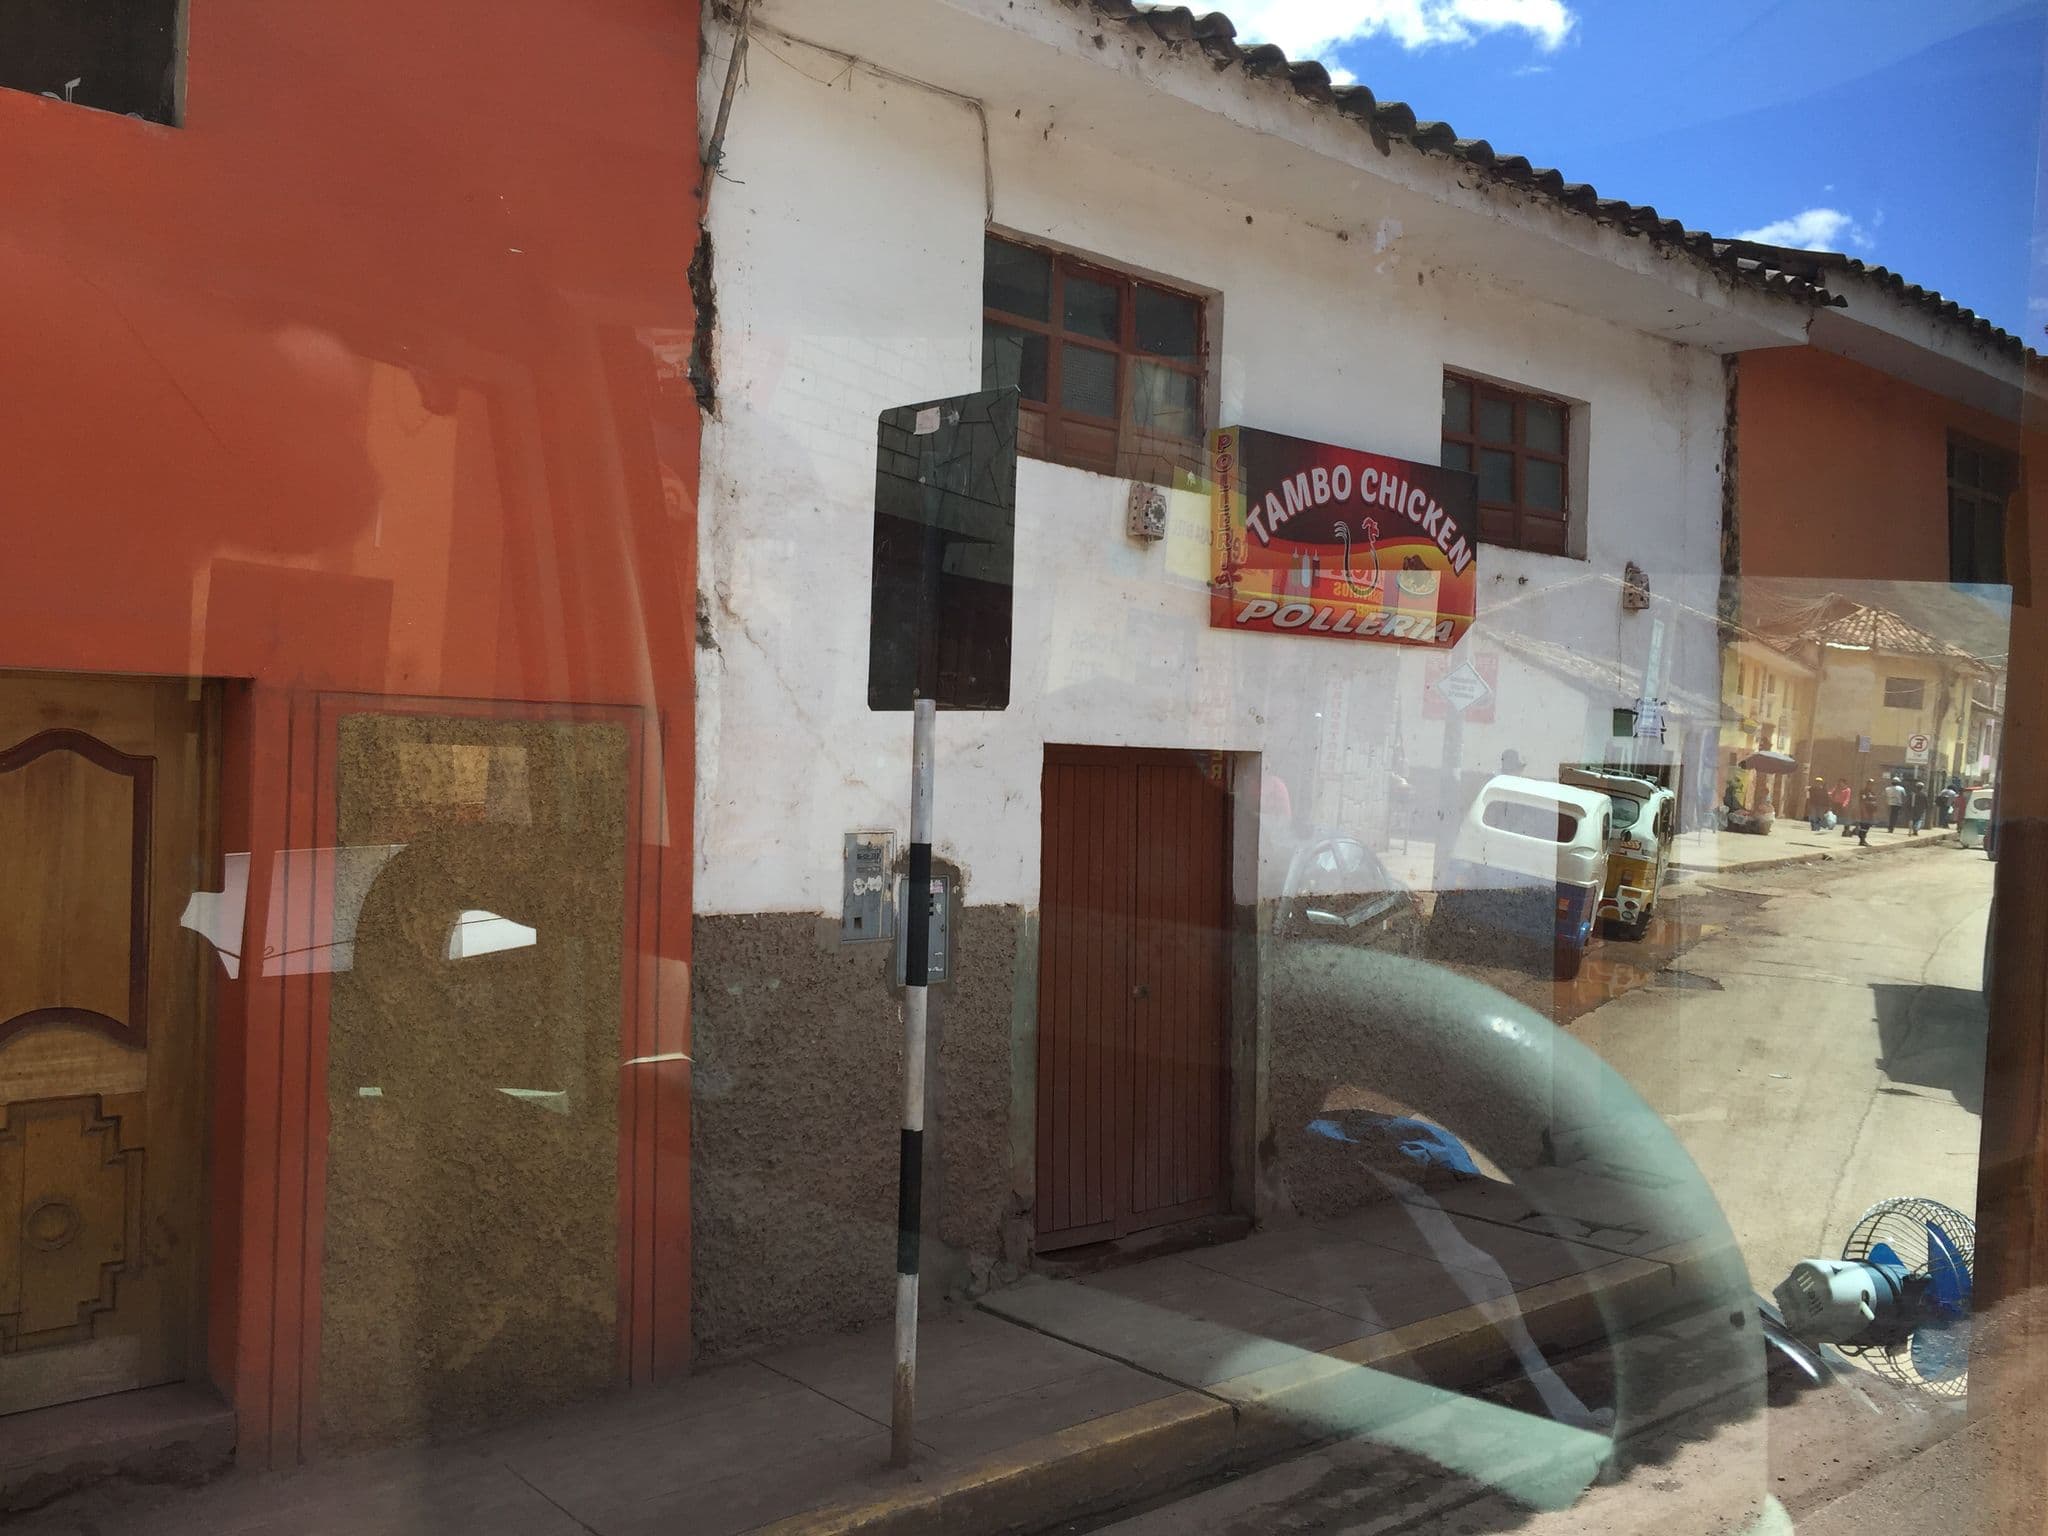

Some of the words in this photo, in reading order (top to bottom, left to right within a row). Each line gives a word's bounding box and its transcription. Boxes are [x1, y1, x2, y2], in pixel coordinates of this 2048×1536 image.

[1246, 464, 1352, 547] TAMBO
[1360, 467, 1473, 577] CHICKEN
[1236, 599, 1456, 643] POLLERIA
